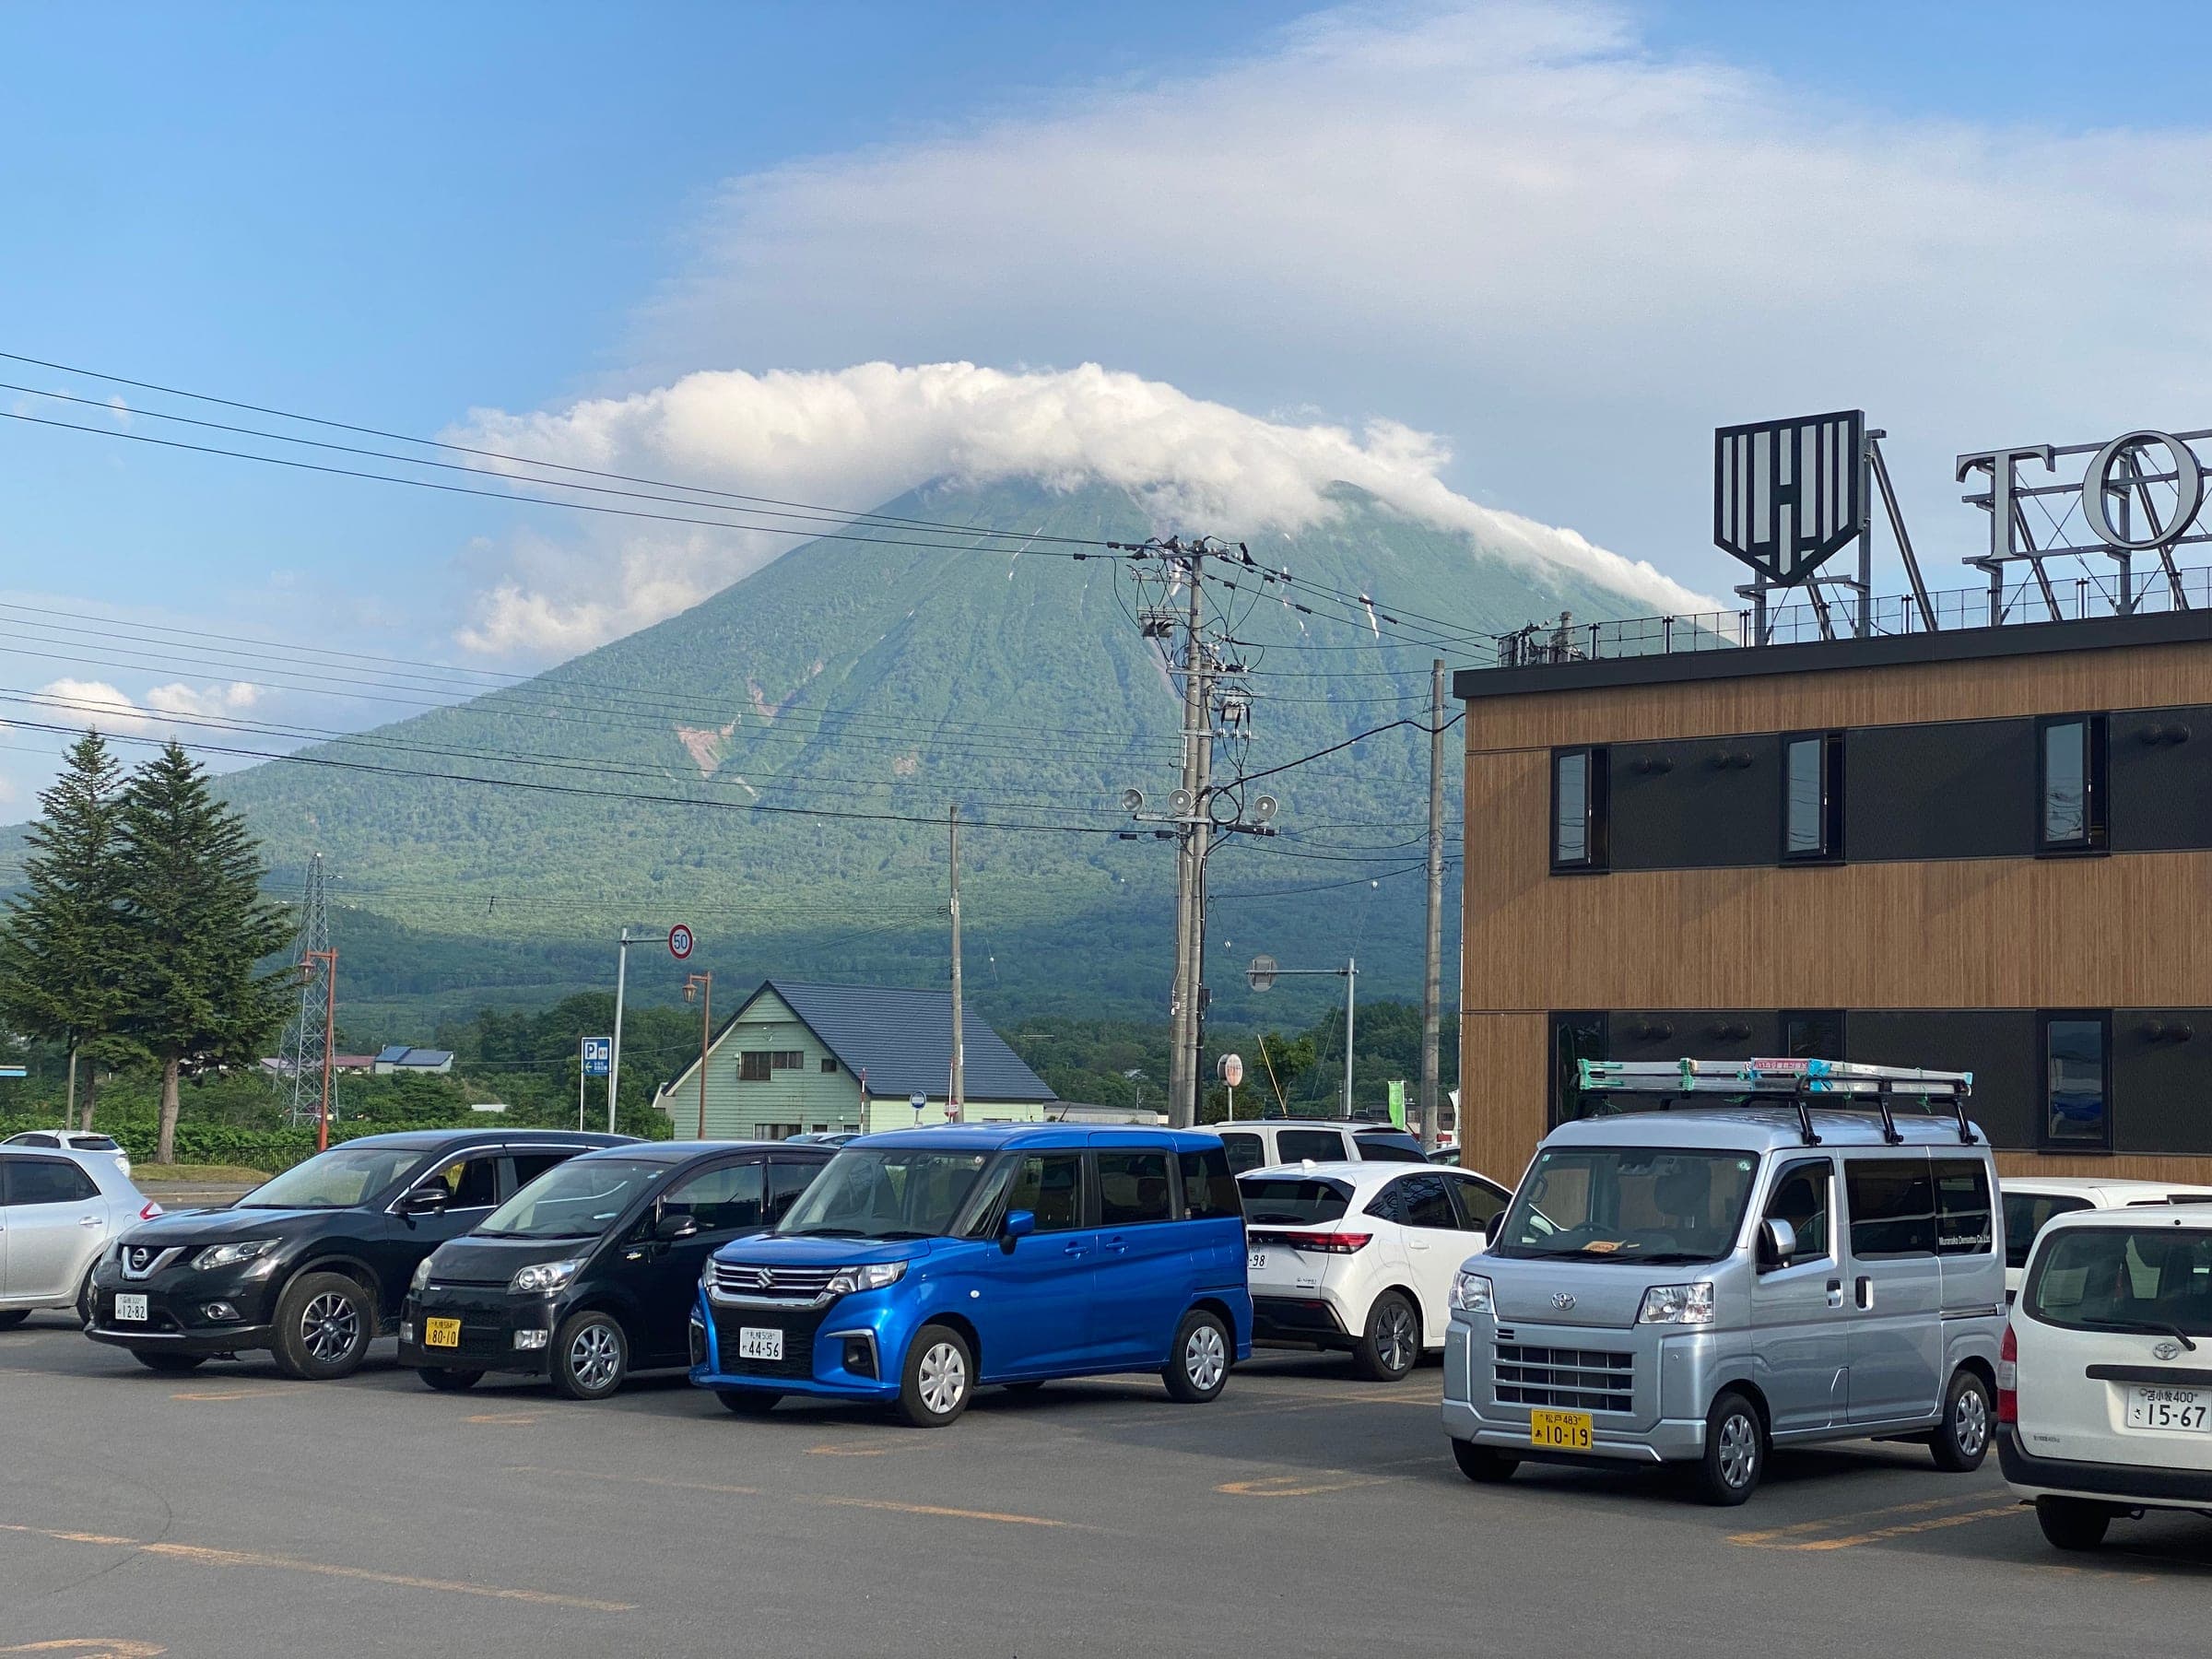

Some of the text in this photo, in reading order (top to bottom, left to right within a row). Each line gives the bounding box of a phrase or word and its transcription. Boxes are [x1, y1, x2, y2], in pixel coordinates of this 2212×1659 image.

[674, 934, 688, 949] 50
[586, 1043, 595, 1058] P
[123, 1304, 145, 1319] 12-82
[432, 1329, 456, 1345] 80-10
[748, 1340, 779, 1358] 44-56
[2134, 1404, 2206, 1428] さ 15-67
[1547, 1425, 1588, 1446] 10-19
